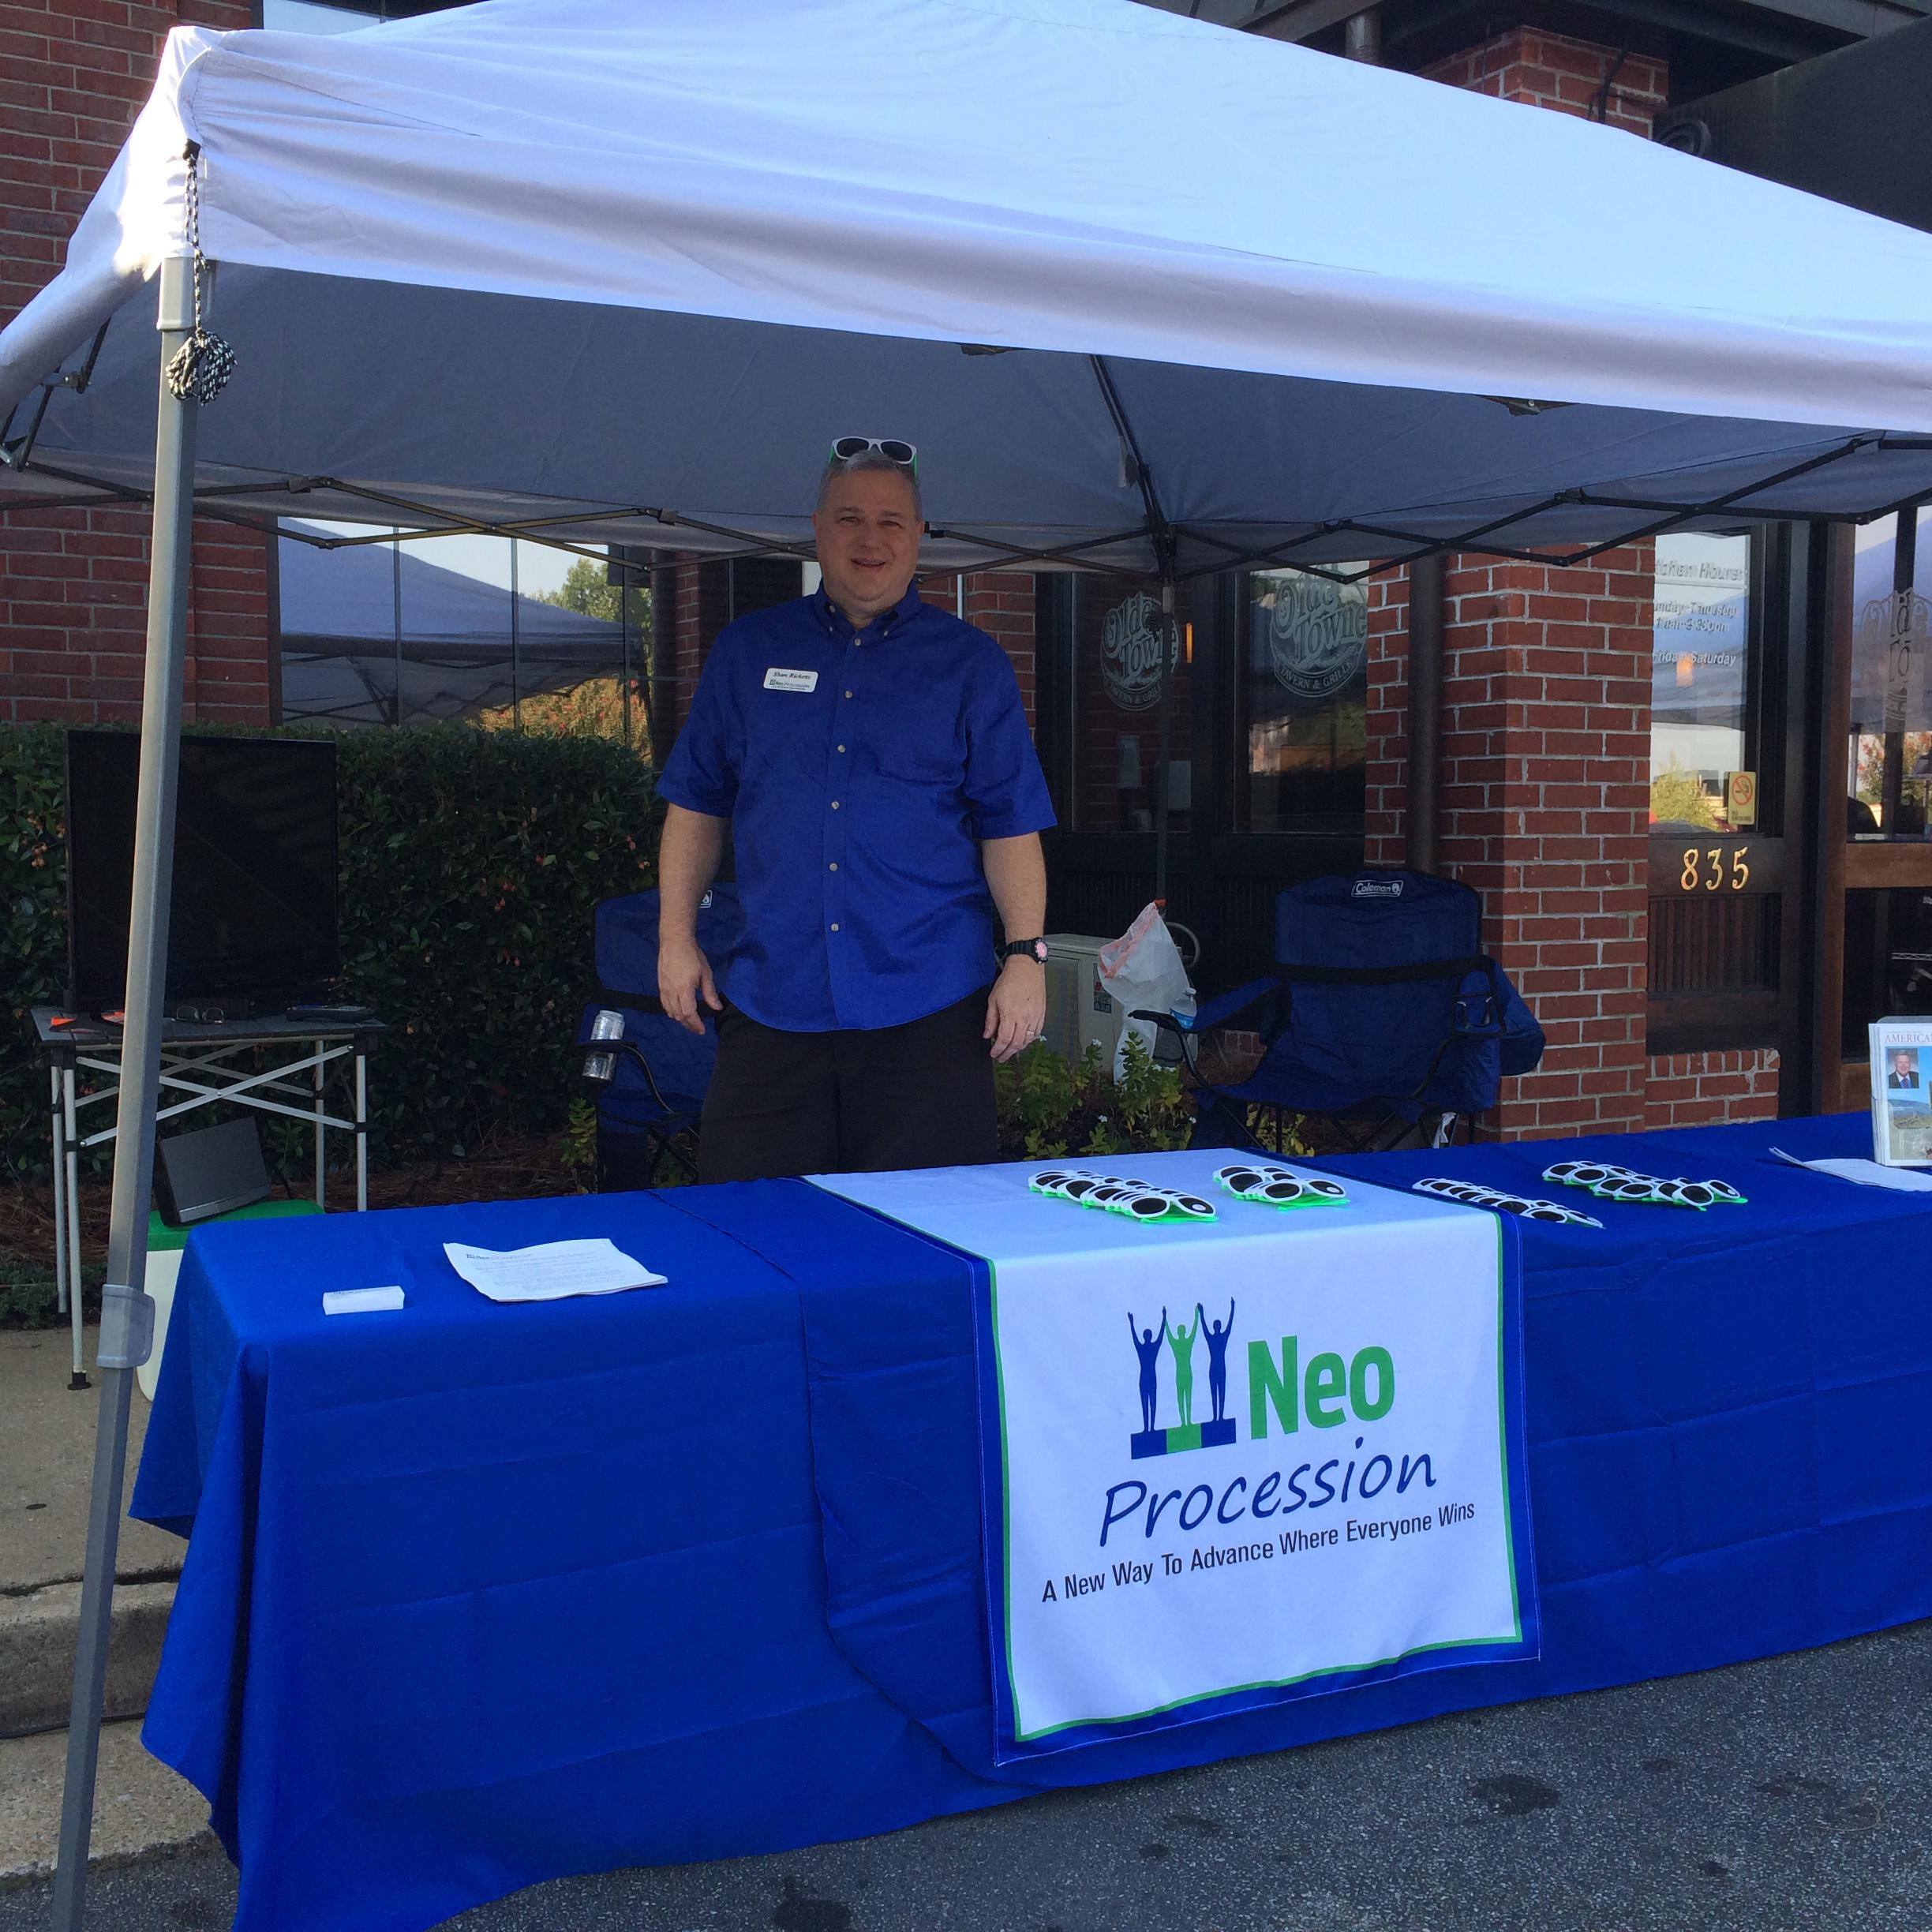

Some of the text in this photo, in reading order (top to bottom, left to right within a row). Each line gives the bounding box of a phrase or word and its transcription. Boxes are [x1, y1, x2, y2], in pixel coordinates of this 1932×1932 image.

[1280, 665, 1310, 690] TAVERN
[1355, 882, 1391, 893] Coleman
[1680, 846, 1749, 891] 835
[1885, 1034, 1932, 1043] AMERICA
[1249, 1335, 1396, 1440] Neo
[1100, 1436, 1438, 1548] Procession
[1042, 1502, 1476, 1603] A New Way To Advance Where Everyone Wins
